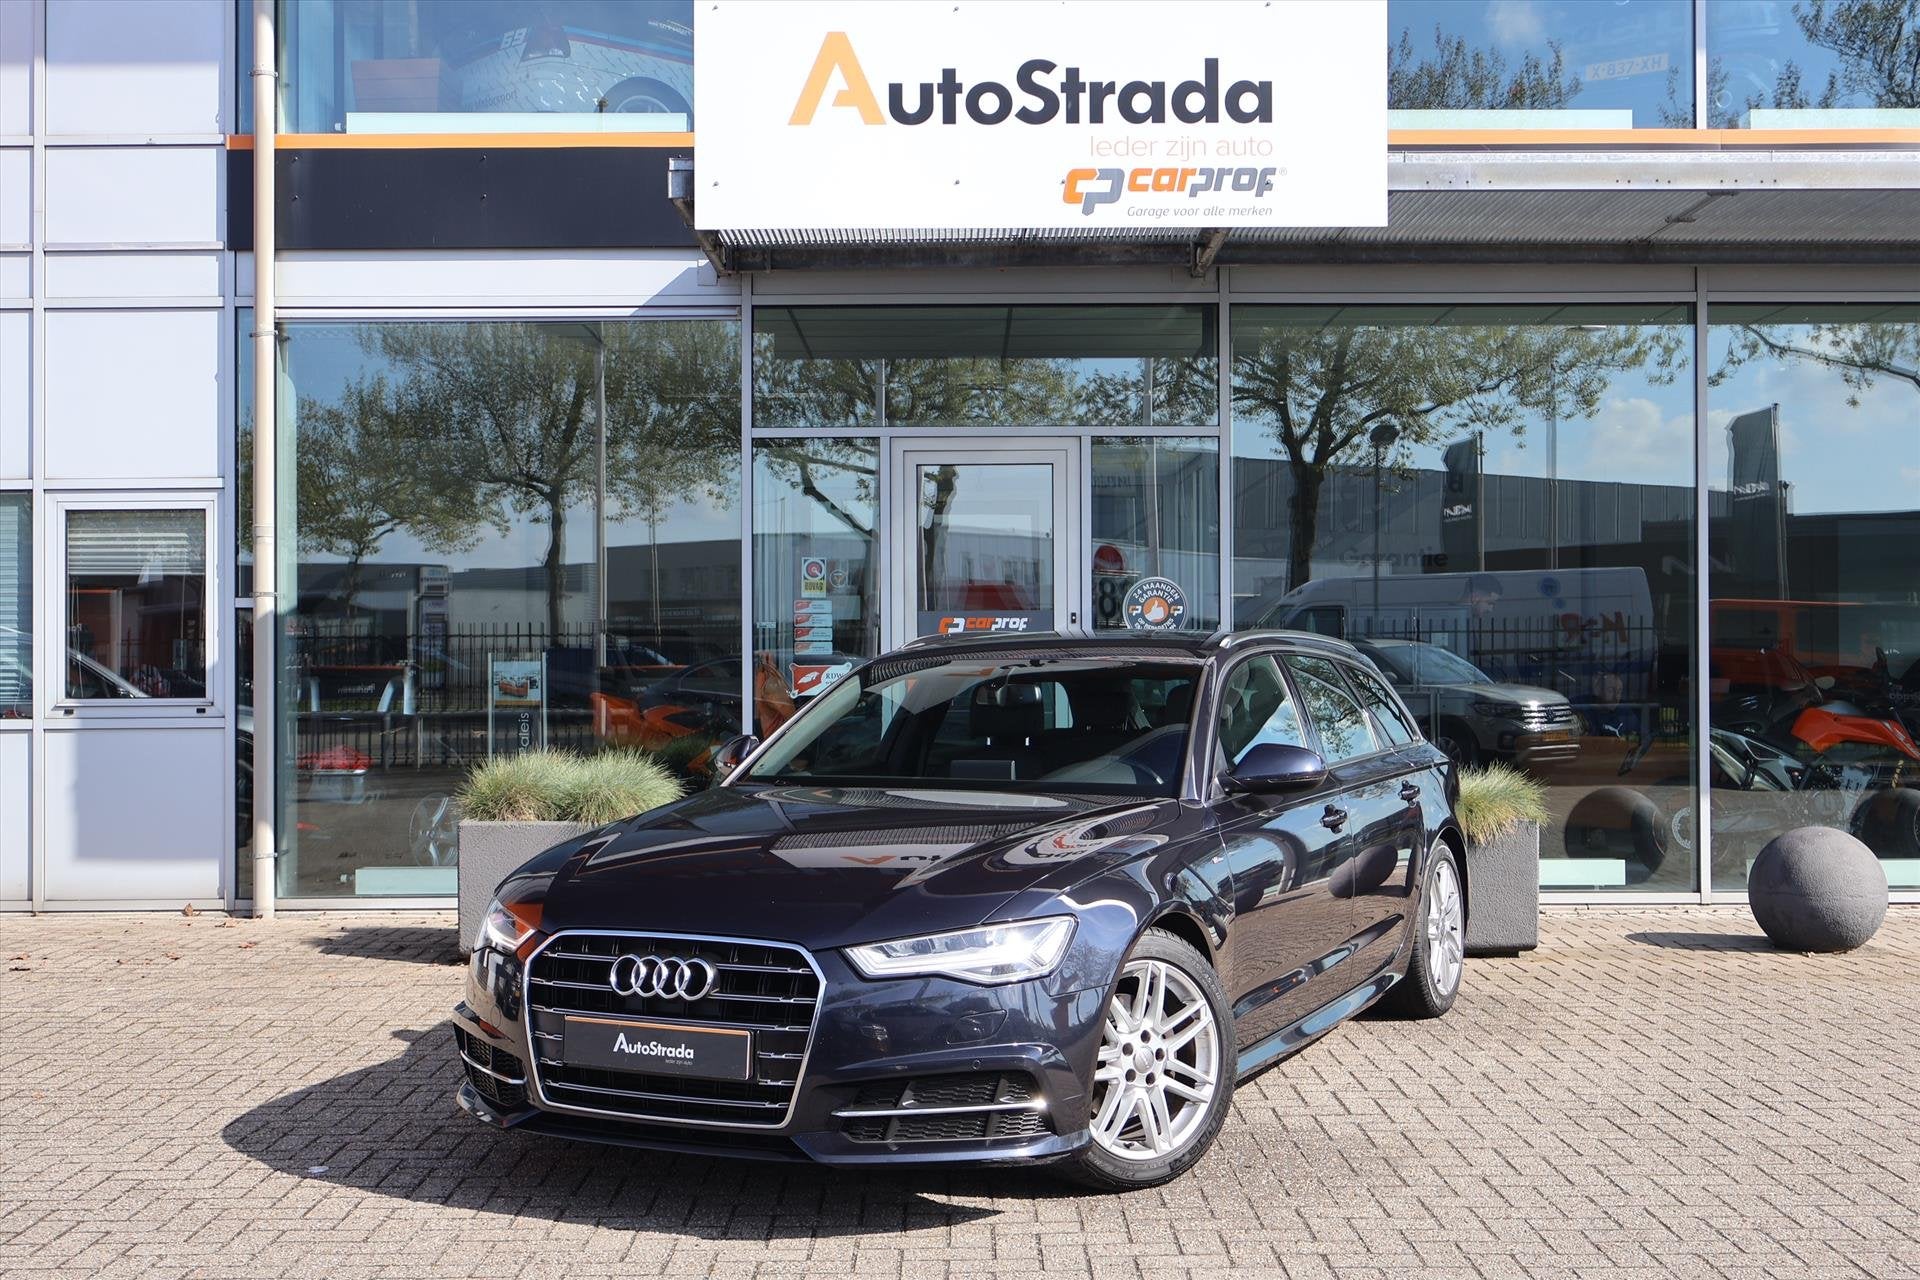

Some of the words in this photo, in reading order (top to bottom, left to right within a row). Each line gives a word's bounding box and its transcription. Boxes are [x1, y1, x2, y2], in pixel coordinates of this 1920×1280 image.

[787, 31, 1273, 125] AutoStrada
[1166, 136, 1207, 161] zijn
[1216, 138, 1273, 156] auto
[1127, 168, 1277, 197] carprof
[1127, 206, 1169, 216] Garage
[1173, 208, 1201, 216] voor
[1203, 206, 1225, 216] alle
[1228, 206, 1273, 216] merken
[1133, 589, 1142, 599] 24
[1143, 582, 1180, 600] MAANDEN
[1139, 589, 1174, 604] GARANTIE
[965, 617, 1028, 631] carprof
[613, 1032, 694, 1059] AutoStrada
